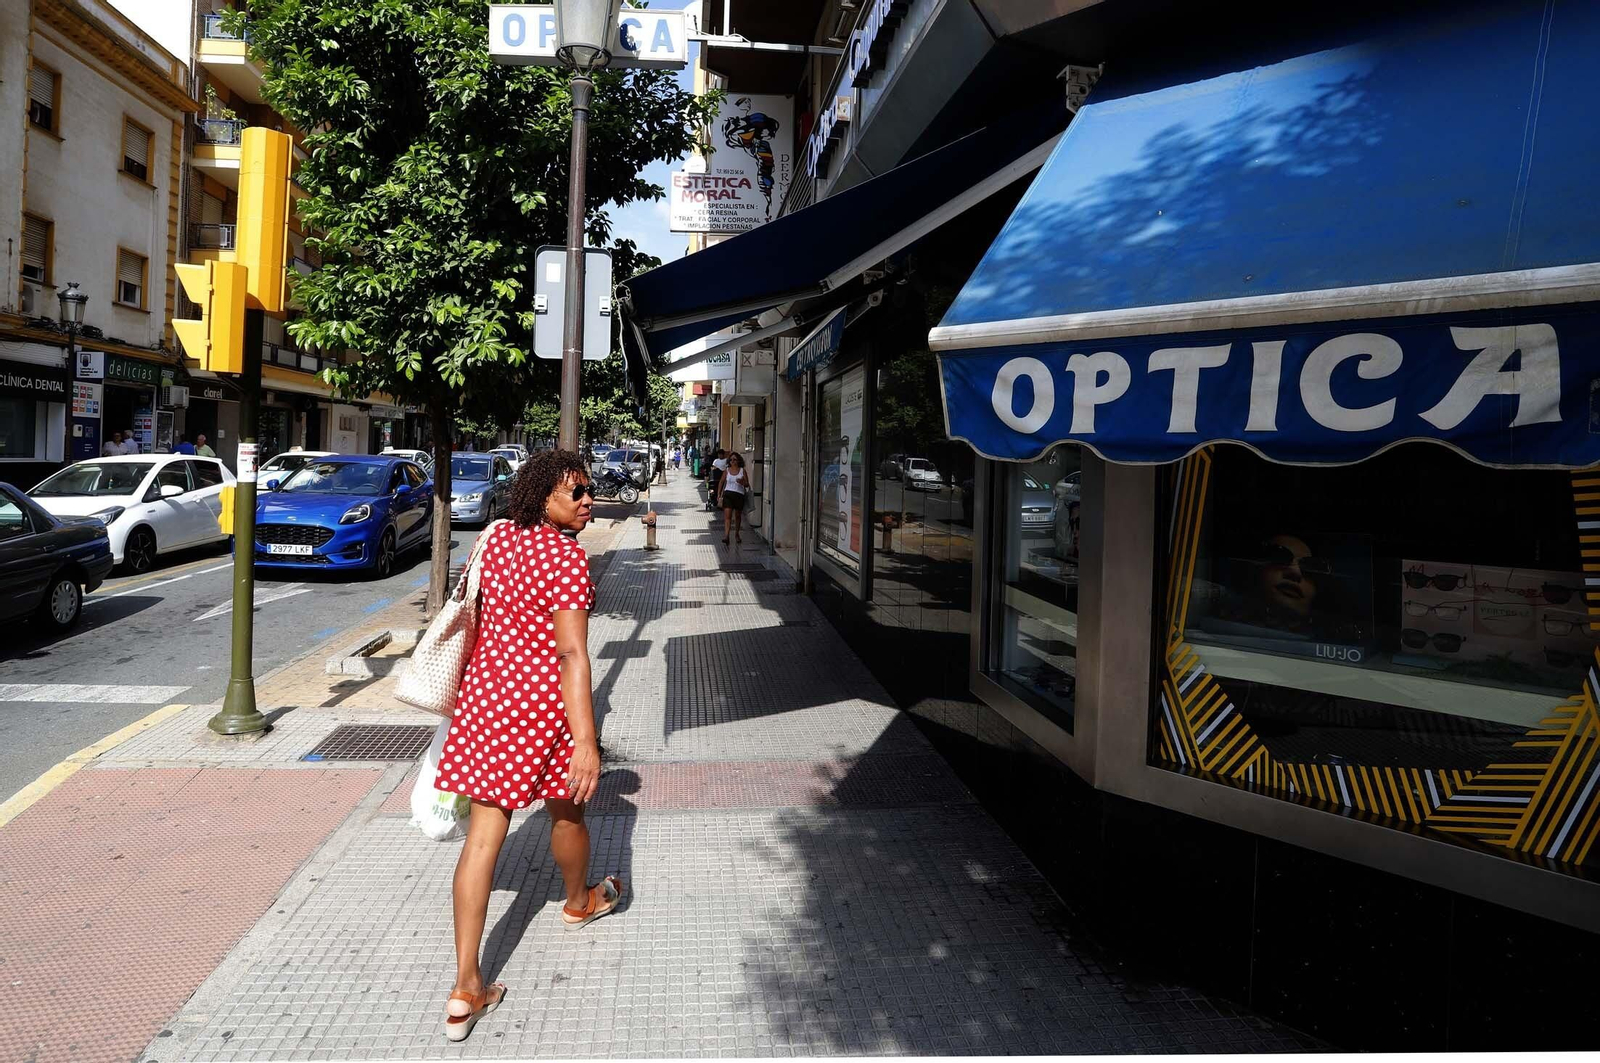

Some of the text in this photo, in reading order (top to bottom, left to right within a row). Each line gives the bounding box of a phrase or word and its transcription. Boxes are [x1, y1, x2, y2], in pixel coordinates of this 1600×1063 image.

[503, 13, 675, 53] OPCA
[673, 175, 752, 189] ESTETICA
[681, 189, 742, 203] MORAL
[109, 359, 153, 381] delicias
[35, 378, 65, 393] DENTAL
[991, 323, 1563, 434] OPTICA
[203, 386, 223, 399] clarel
[273, 545, 293, 553] 2977
